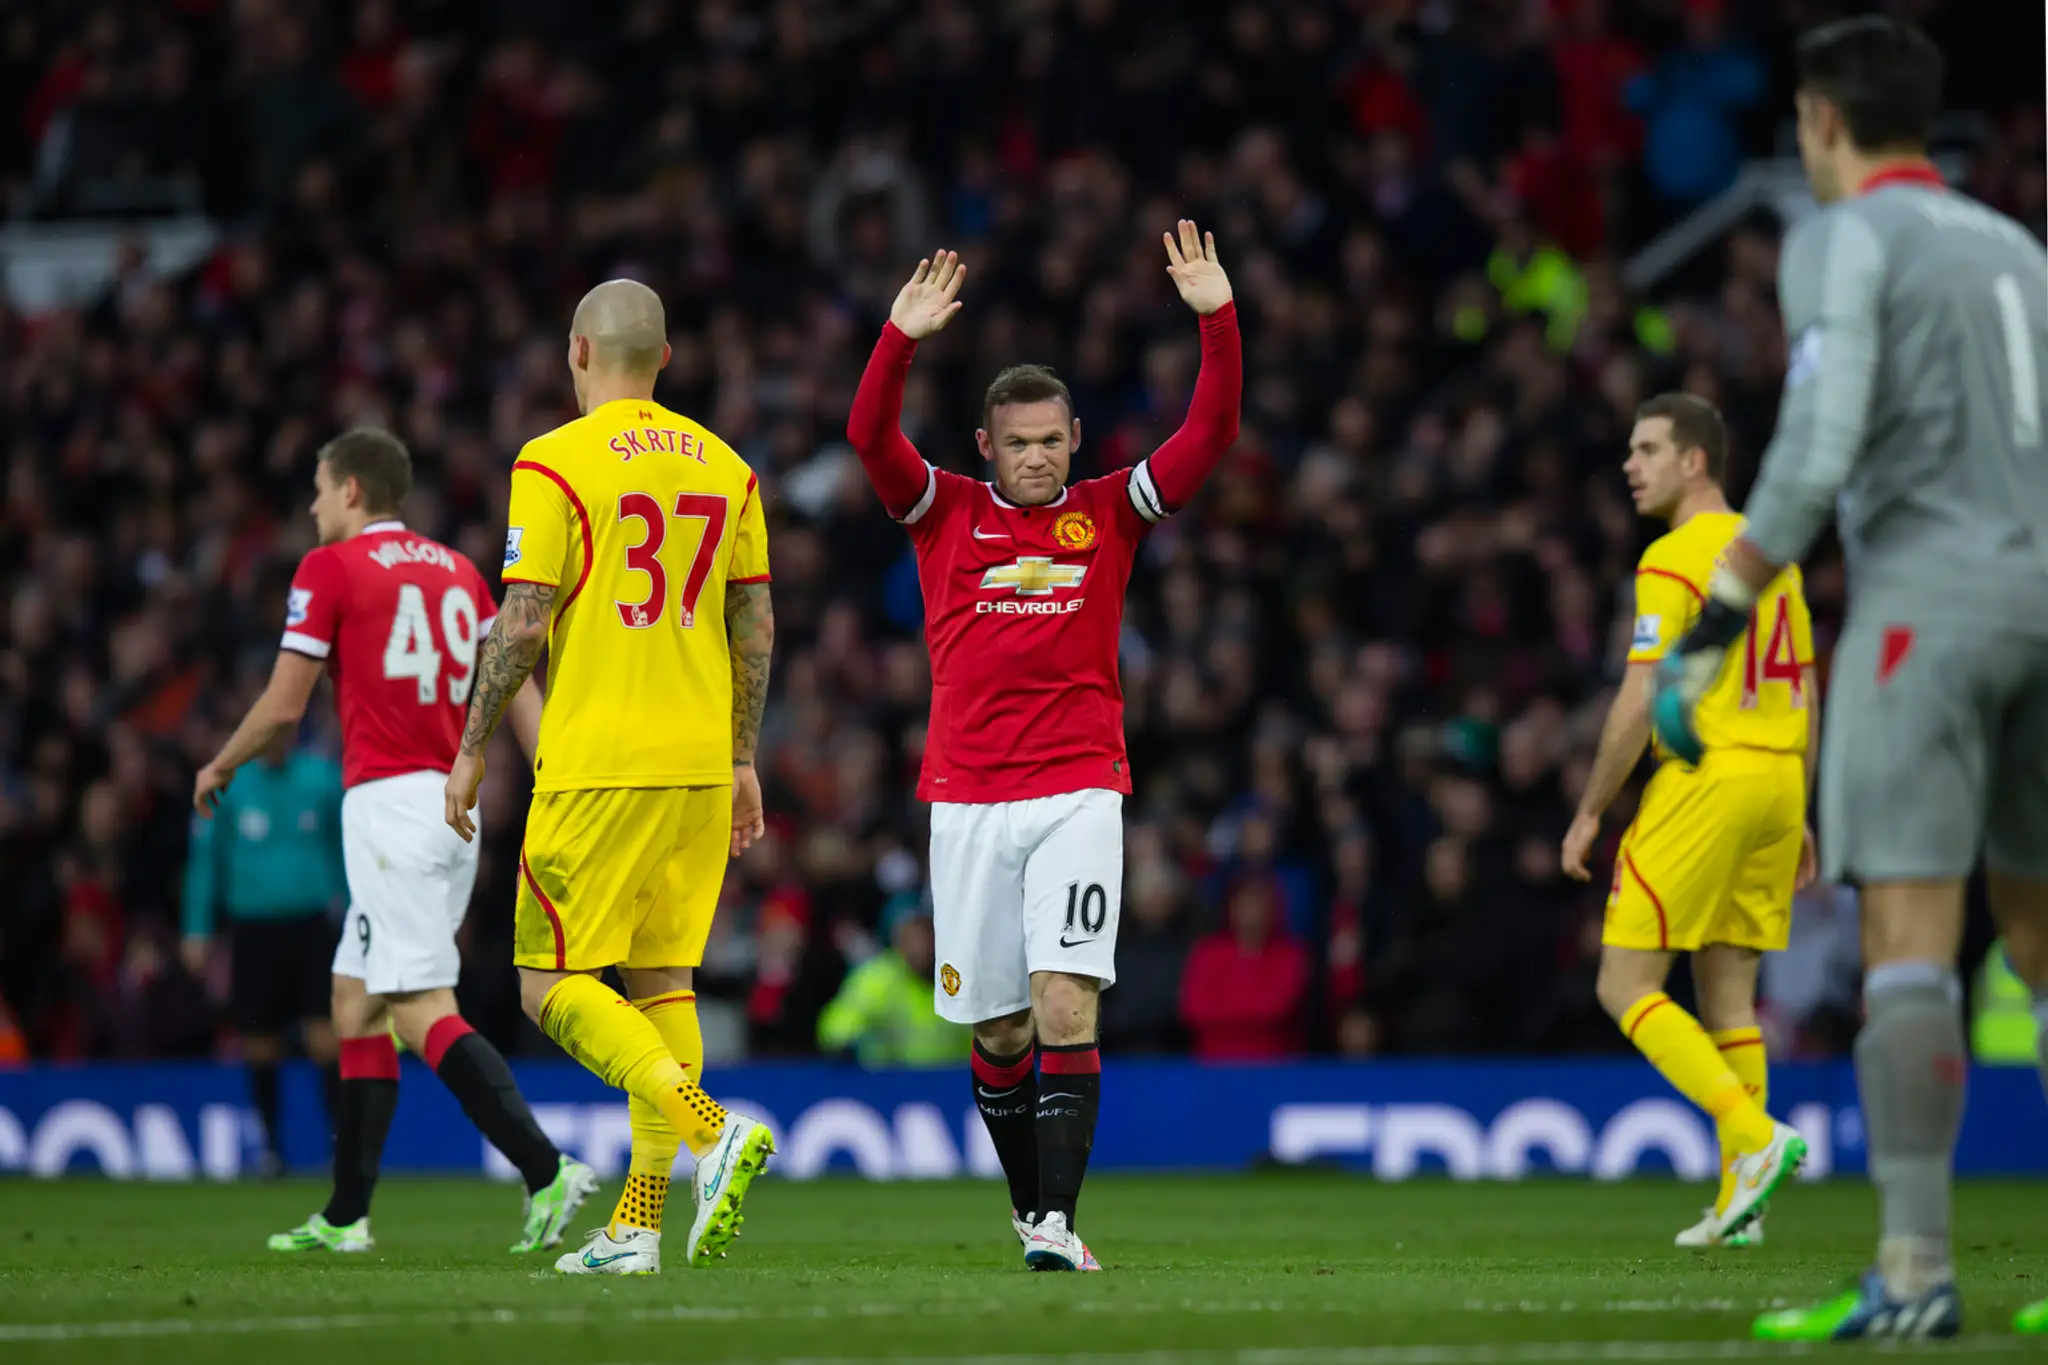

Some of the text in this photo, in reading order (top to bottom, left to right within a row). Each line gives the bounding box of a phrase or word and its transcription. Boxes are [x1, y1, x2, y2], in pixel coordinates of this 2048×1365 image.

[609, 428, 708, 466] SKRTEL
[368, 540, 456, 573] WILSON
[614, 491, 728, 629] 37
[976, 598, 1086, 615] CHEVROLET
[383, 583, 479, 705] 49
[1738, 593, 1807, 710] 14
[1061, 881, 1107, 934] 10
[1036, 1108, 1079, 1119] MUFC
